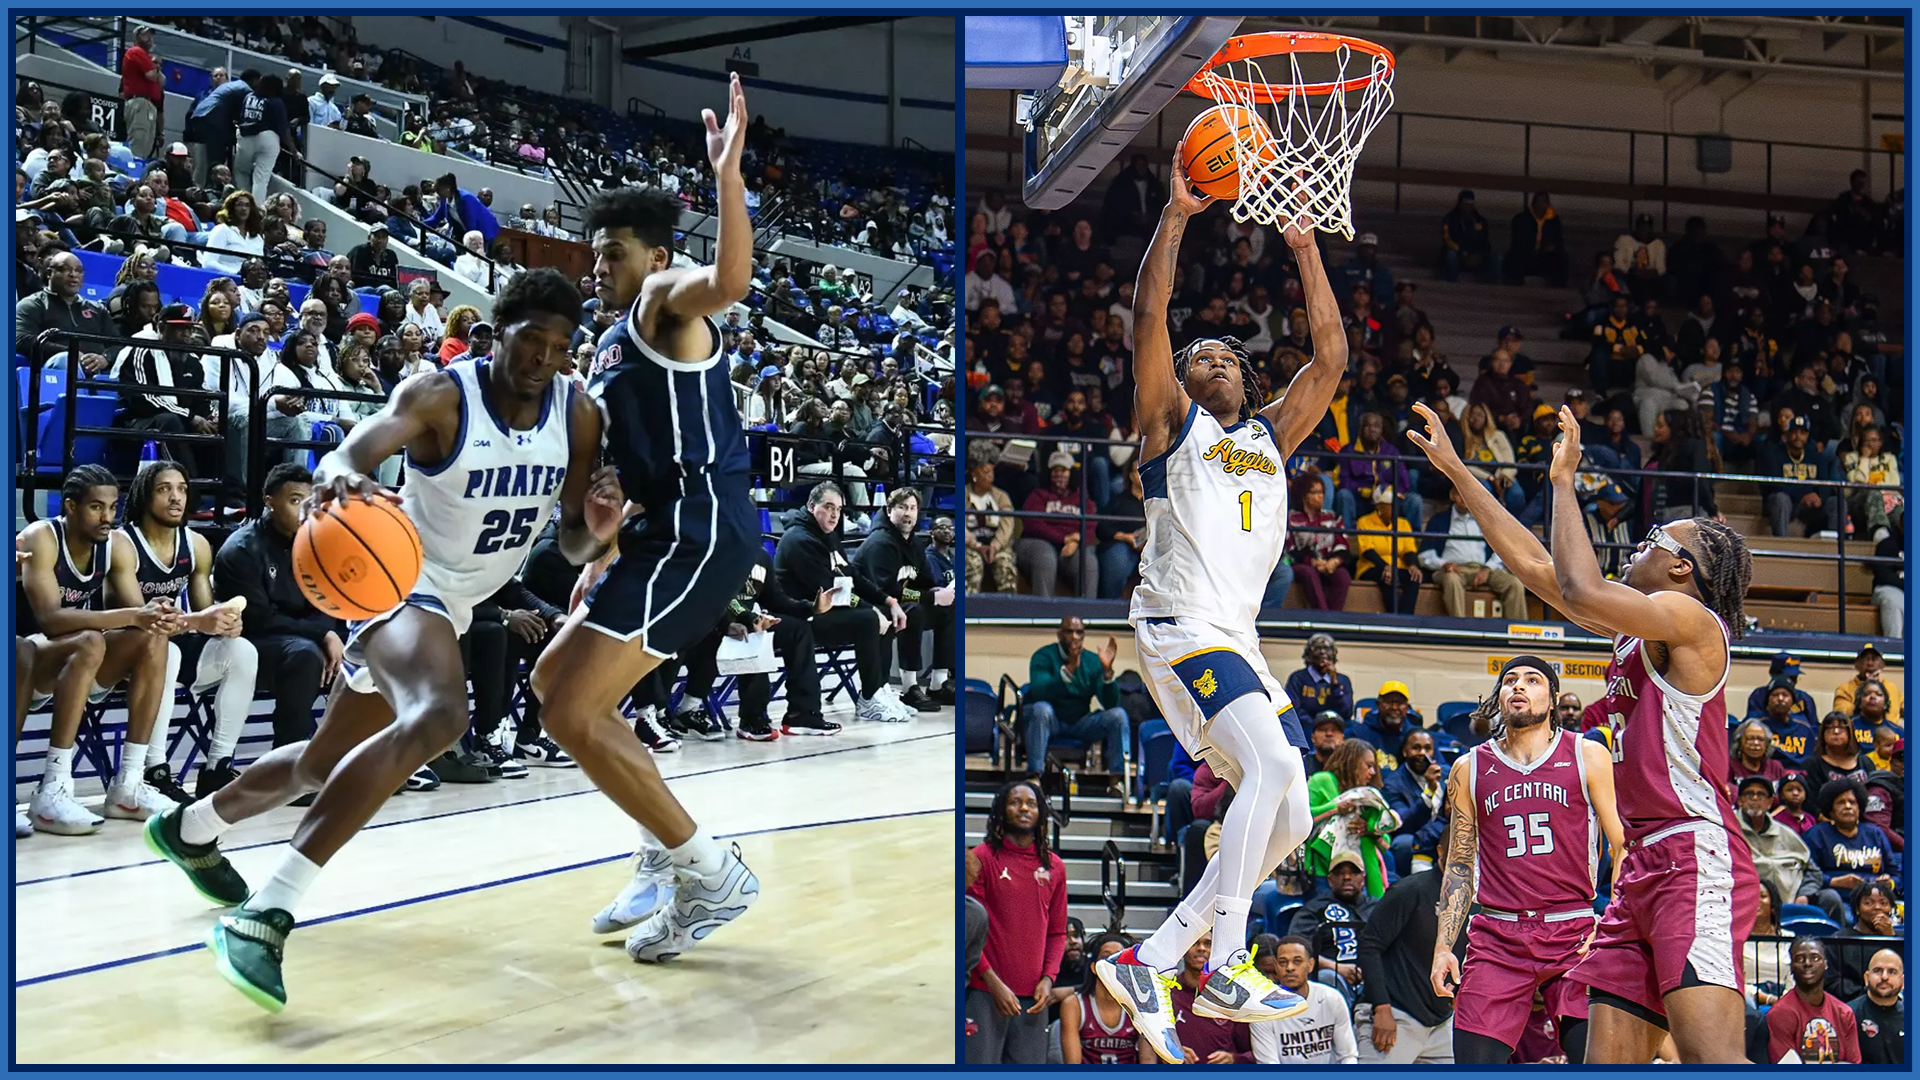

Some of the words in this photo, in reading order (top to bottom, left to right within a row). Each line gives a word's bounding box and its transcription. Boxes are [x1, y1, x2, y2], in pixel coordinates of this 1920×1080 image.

[731, 45, 752, 60] A4
[91, 104, 116, 132] B1
[858, 279, 871, 295] A2
[473, 439, 491, 448] CAA
[1203, 437, 1278, 477] Aggies
[770, 446, 794, 483] B1
[1238, 490, 1253, 533] 1
[472, 506, 539, 555] 25
[1484, 790, 1500, 816] NC
[1504, 781, 1569, 808] CENTRAL
[1503, 811, 1555, 858] 35
[1280, 1027, 1324, 1046] UNITY
